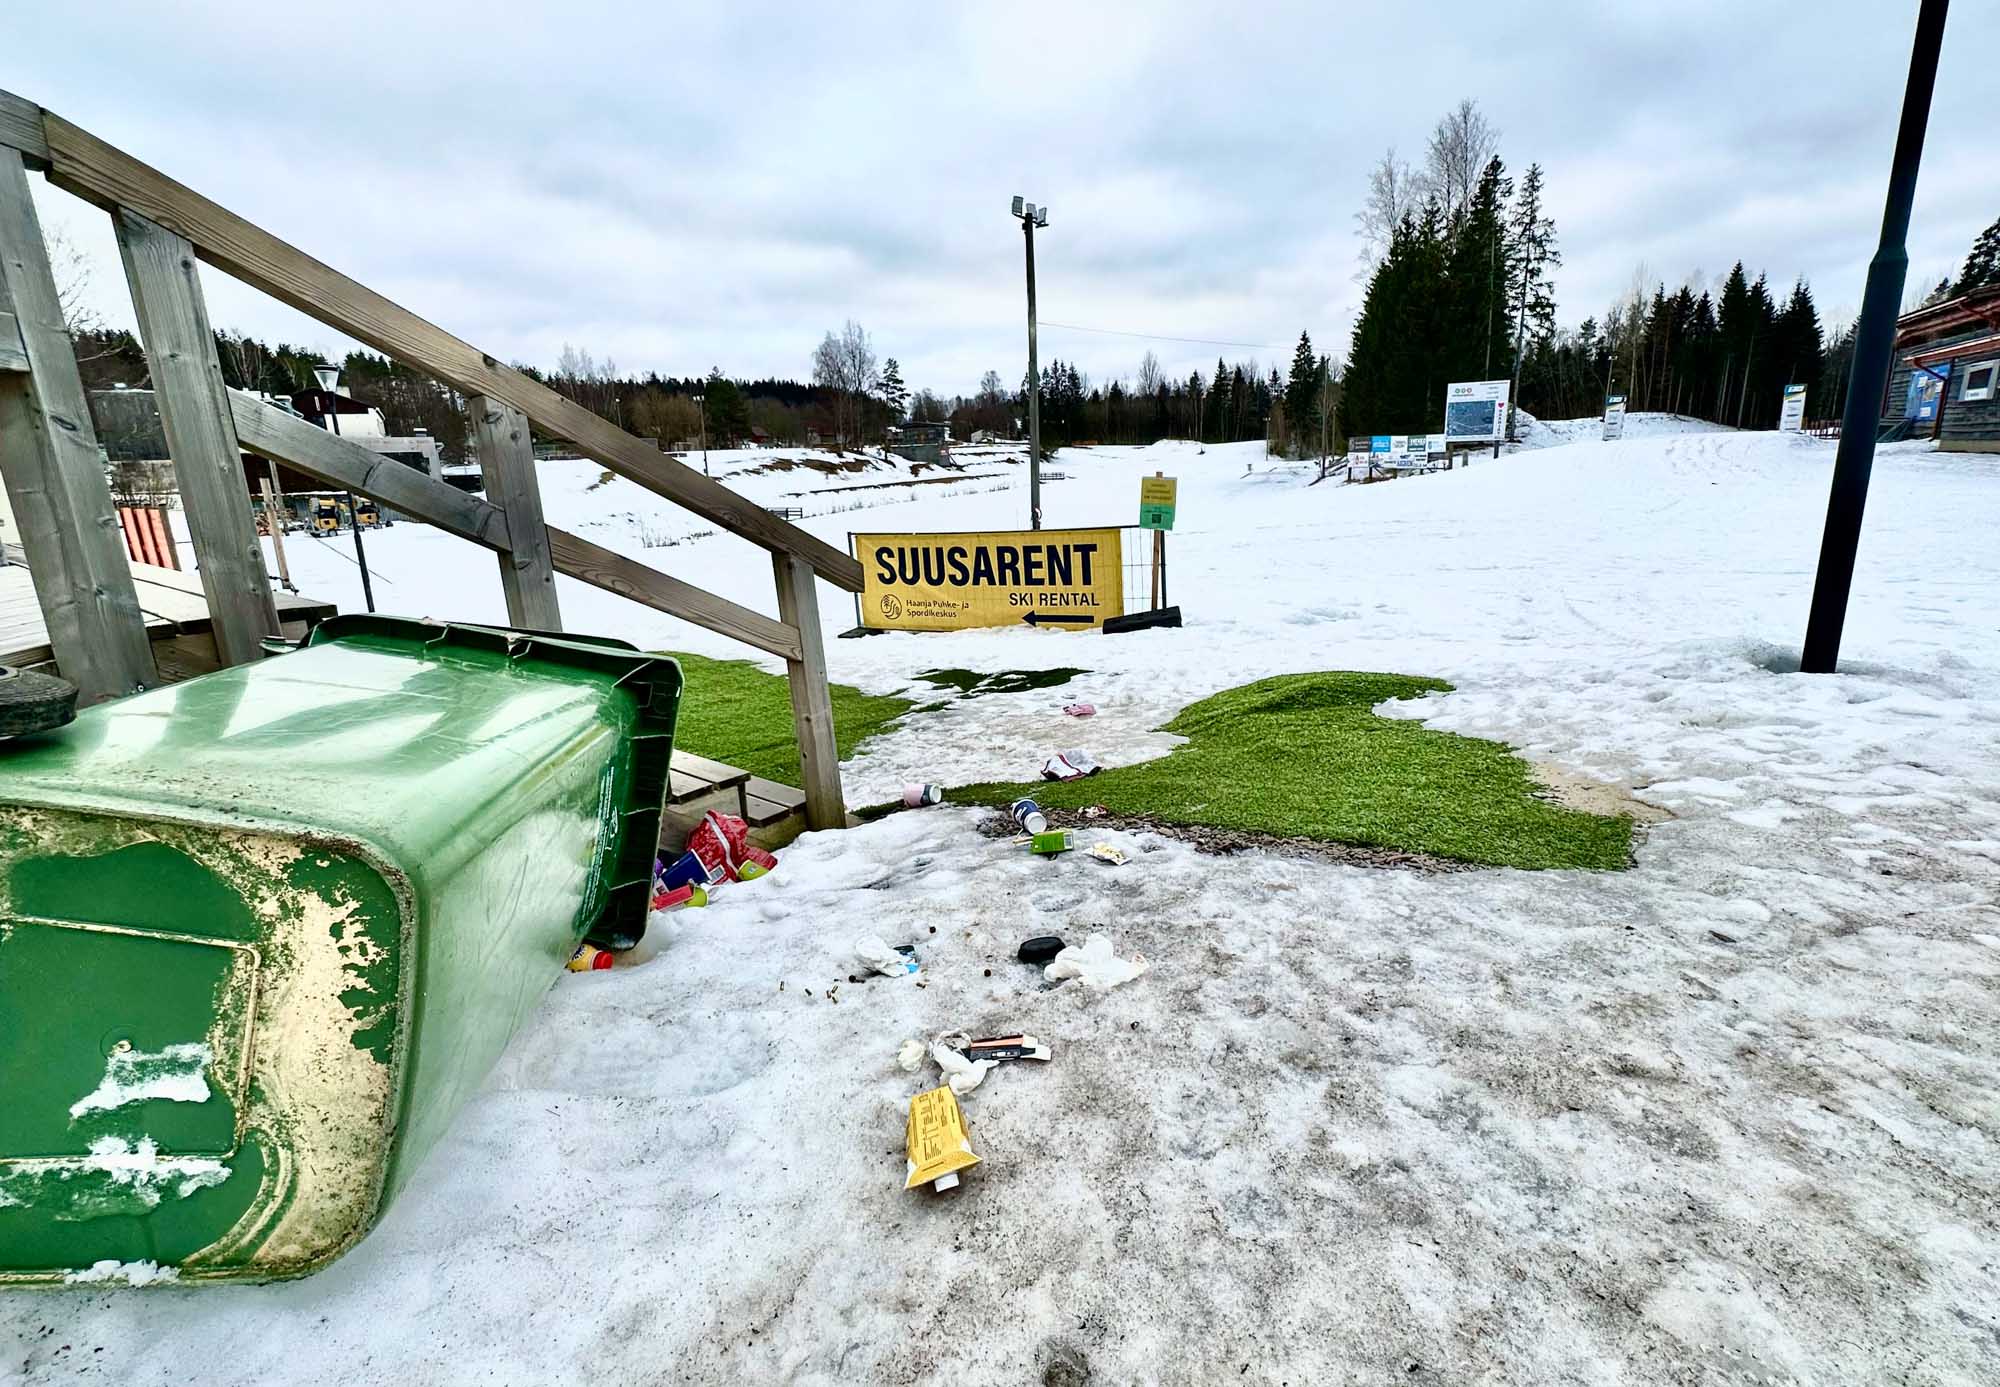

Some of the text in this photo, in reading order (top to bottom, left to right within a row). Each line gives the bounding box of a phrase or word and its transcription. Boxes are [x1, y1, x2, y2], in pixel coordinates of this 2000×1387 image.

[875, 544, 1097, 586] SUUSARENT
[906, 599, 970, 611] Haanja Puhke- ja
[1009, 592, 1100, 606] SKI RENTAL
[907, 609, 957, 619] Spordikeskus
